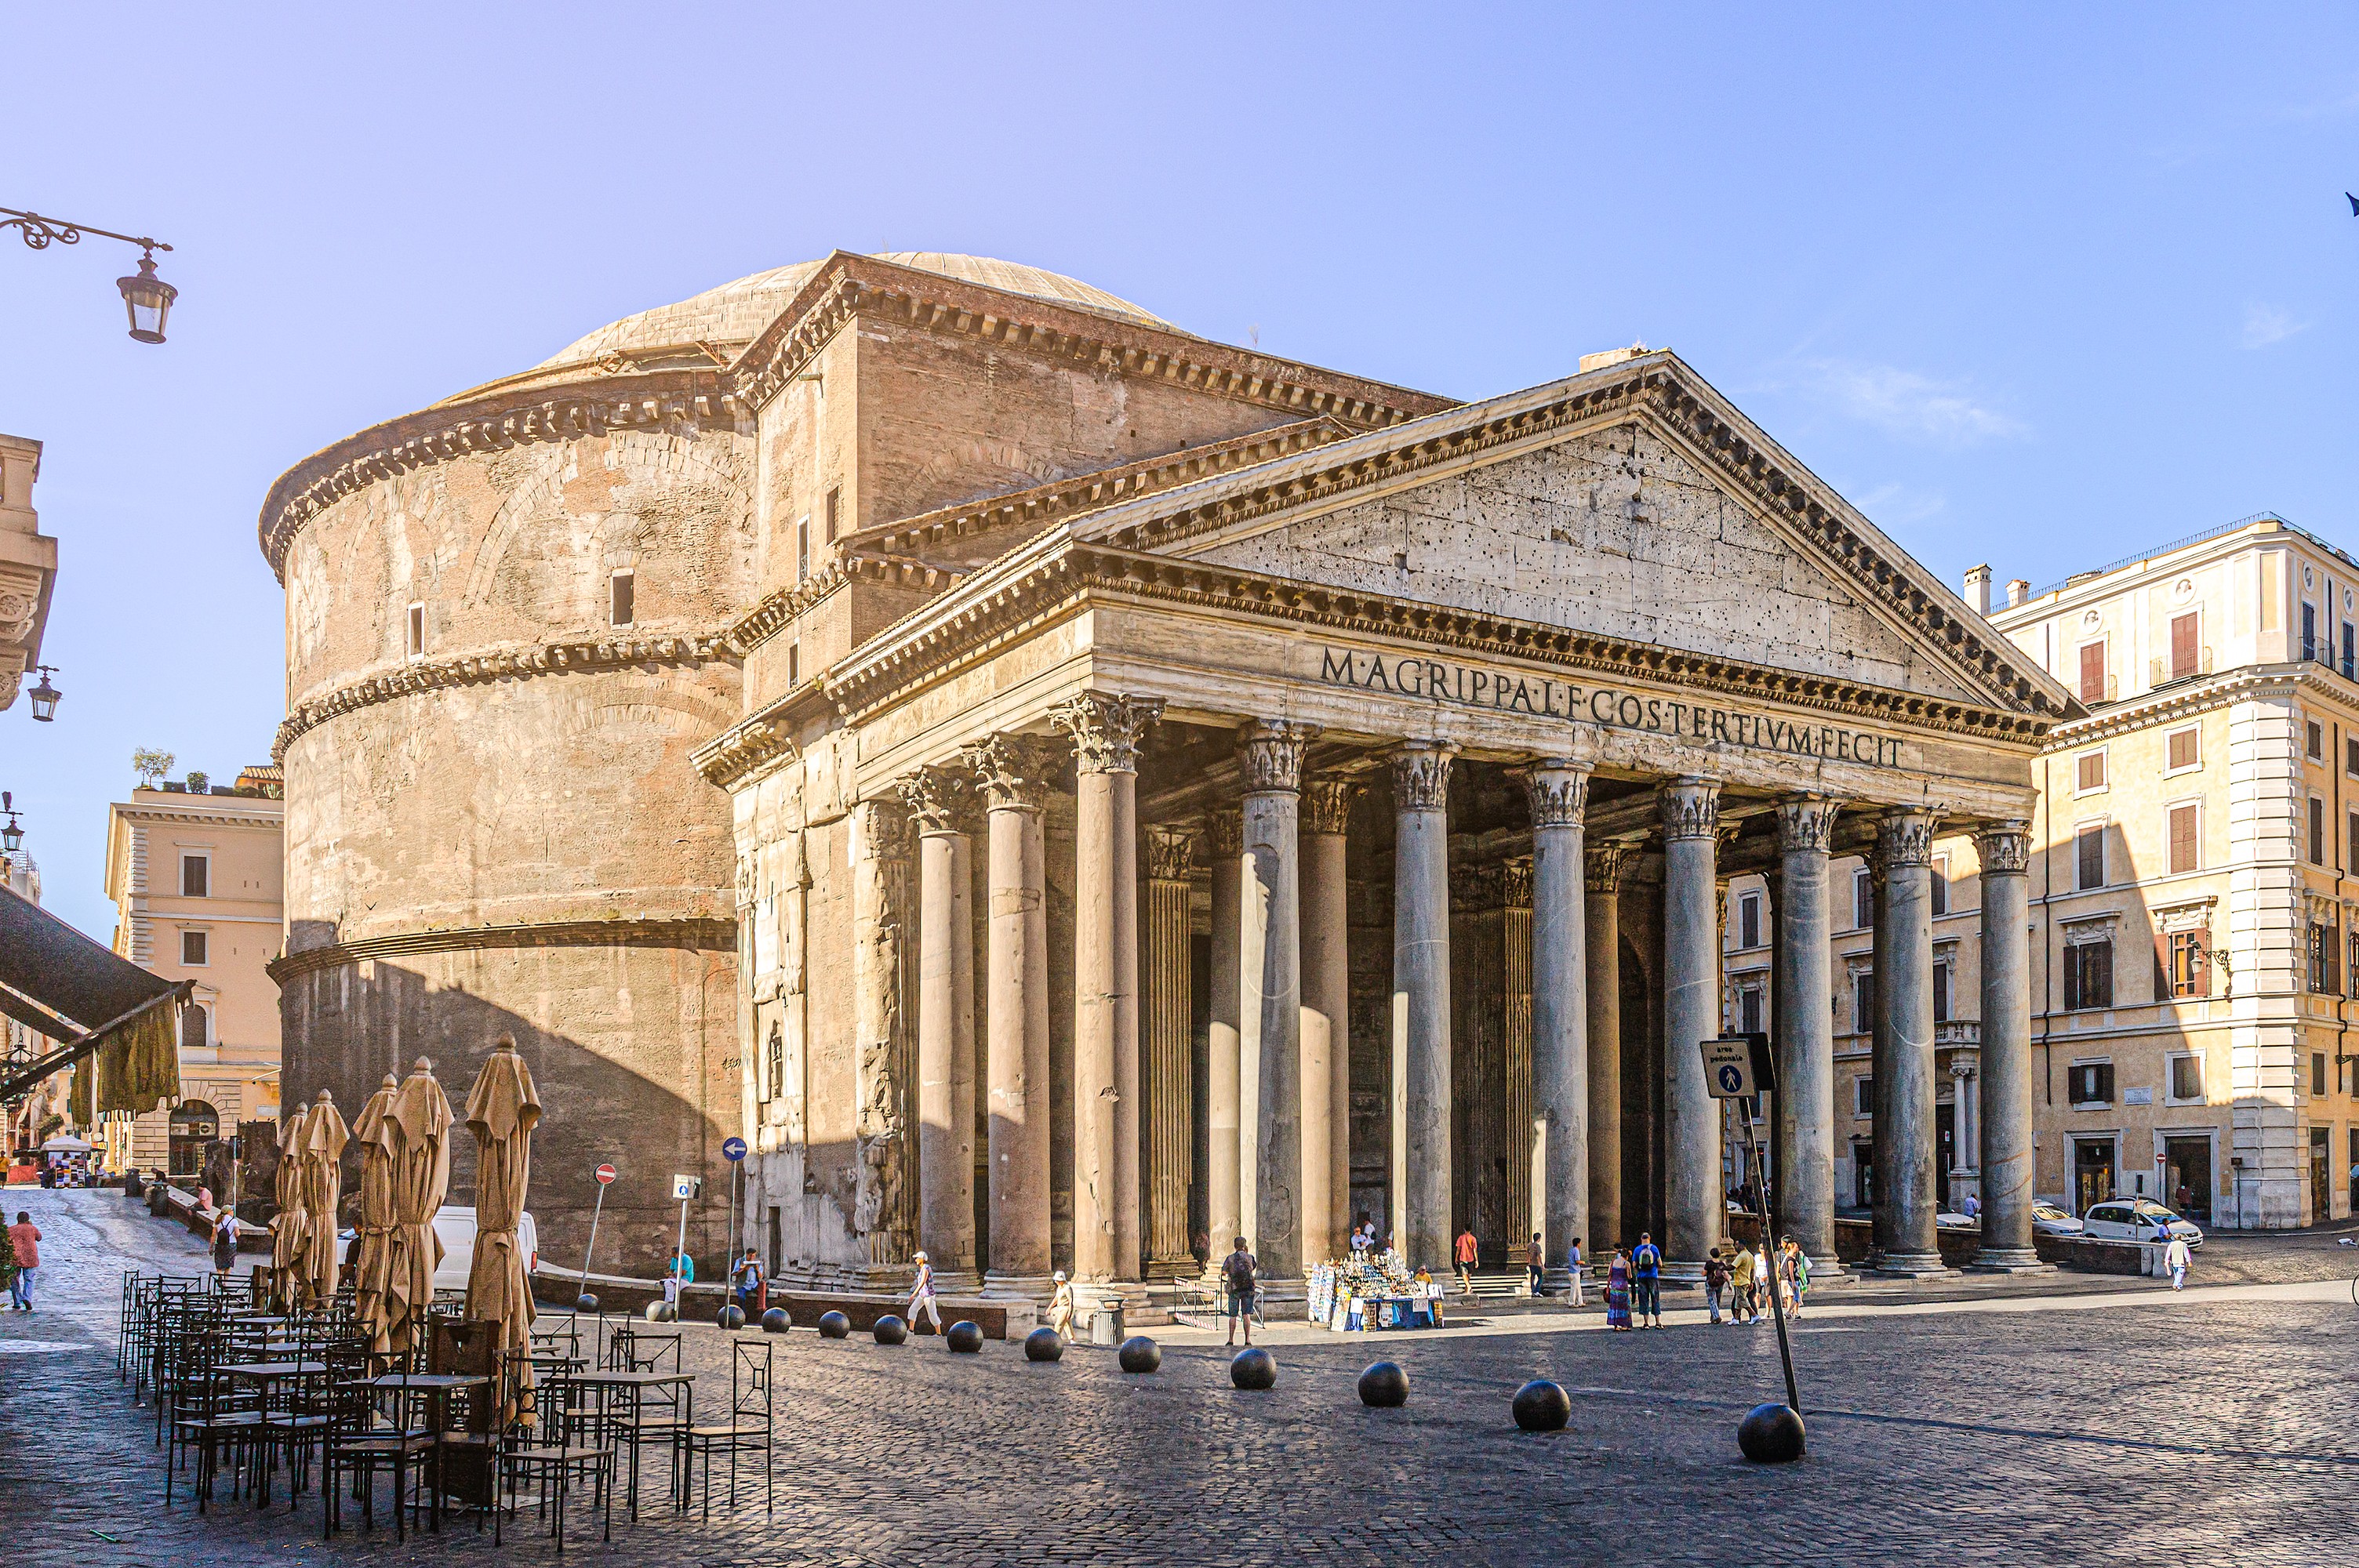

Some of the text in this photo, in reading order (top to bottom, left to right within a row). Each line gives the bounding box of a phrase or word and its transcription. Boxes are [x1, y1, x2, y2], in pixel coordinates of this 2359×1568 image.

[1321, 646, 1358, 684] M
[1365, 655, 1537, 714] AGRIPPA
[1590, 689, 1662, 731] COS
[1668, 702, 1816, 756] TERTIVM
[1819, 728, 1904, 769] FECIT
